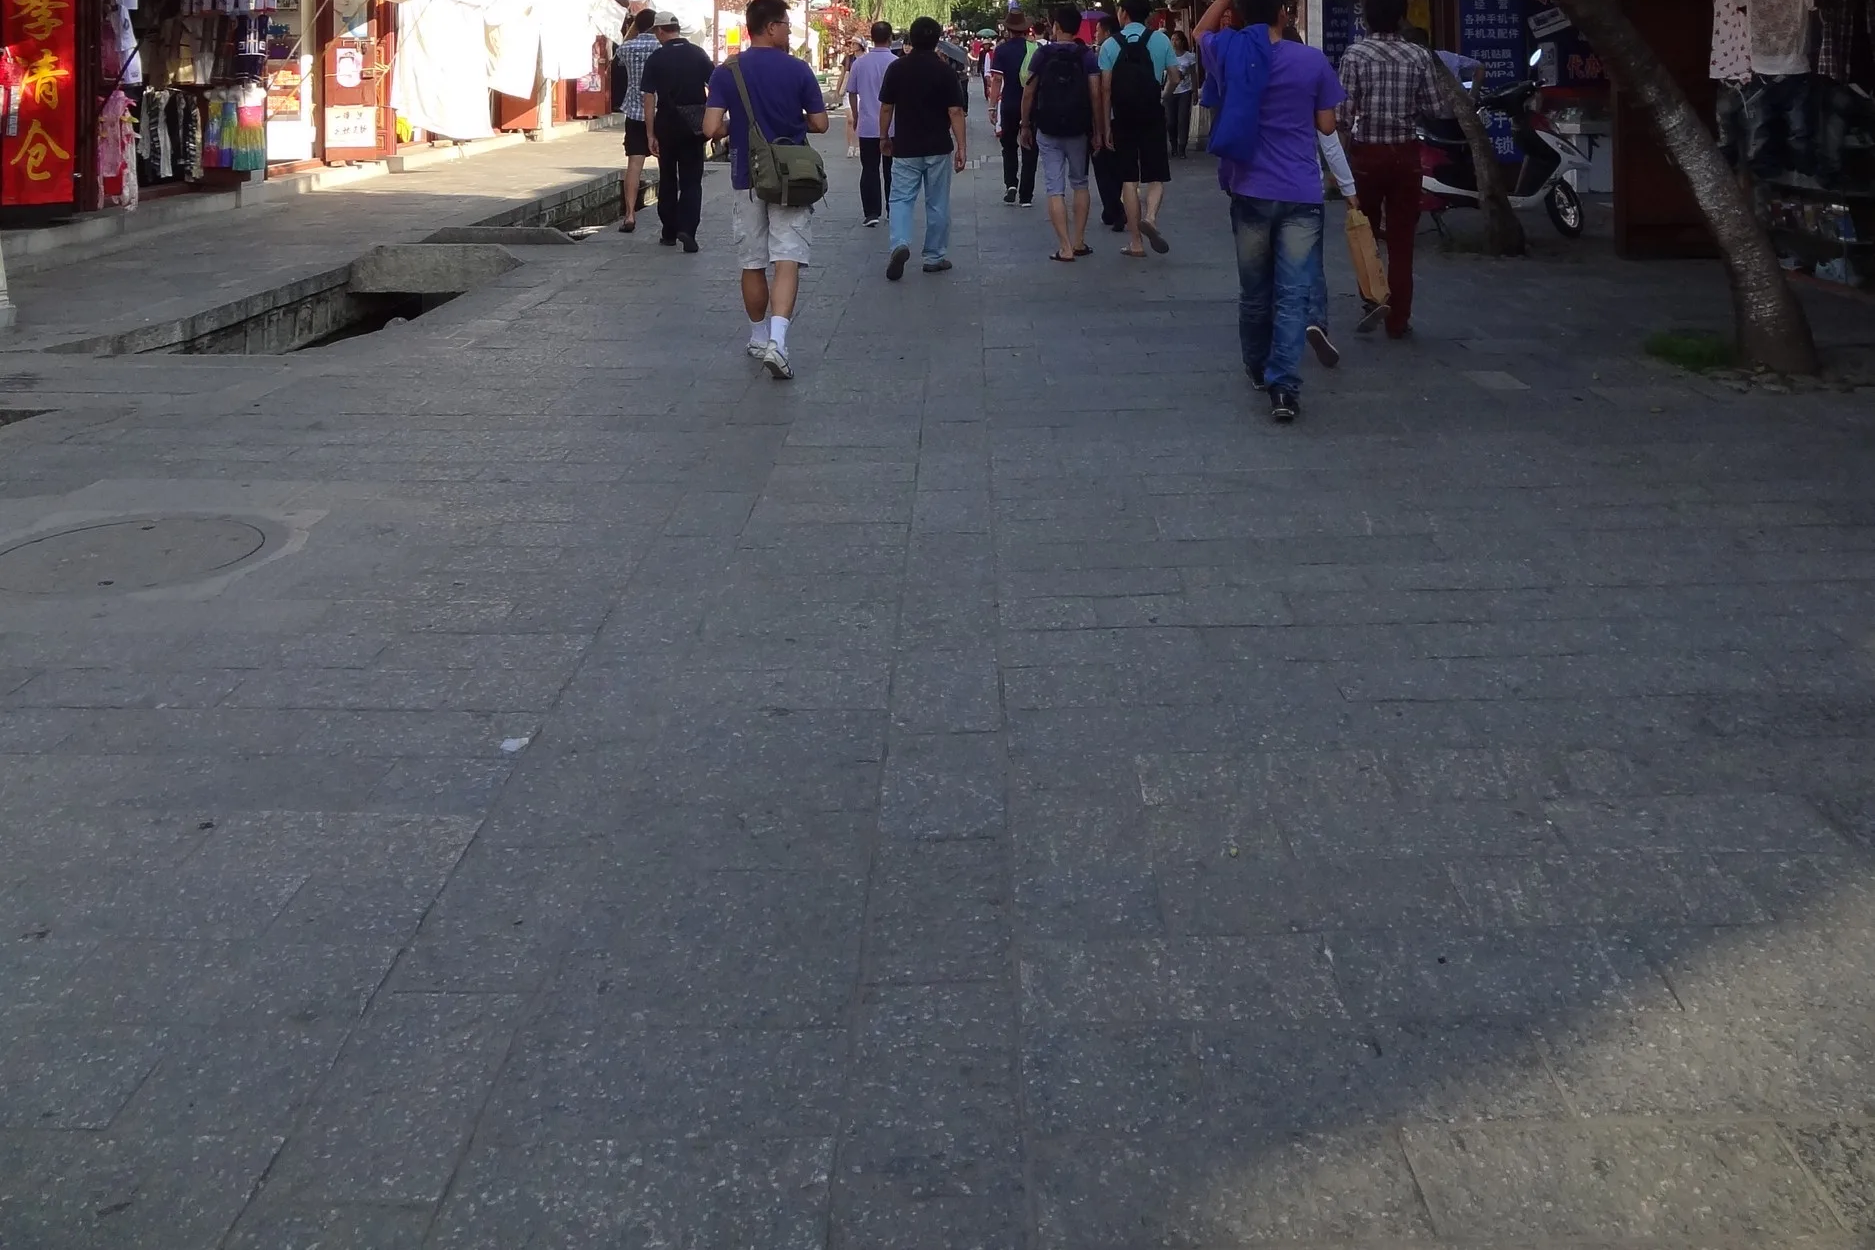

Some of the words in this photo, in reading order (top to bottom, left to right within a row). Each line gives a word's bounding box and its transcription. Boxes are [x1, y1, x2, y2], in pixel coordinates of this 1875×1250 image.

[1464, 14, 1519, 25] 各种手机卡
[1464, 28, 1519, 39] 手机及配件
[1485, 61, 1515, 69] MP3
[1485, 70, 1515, 78] MP4
